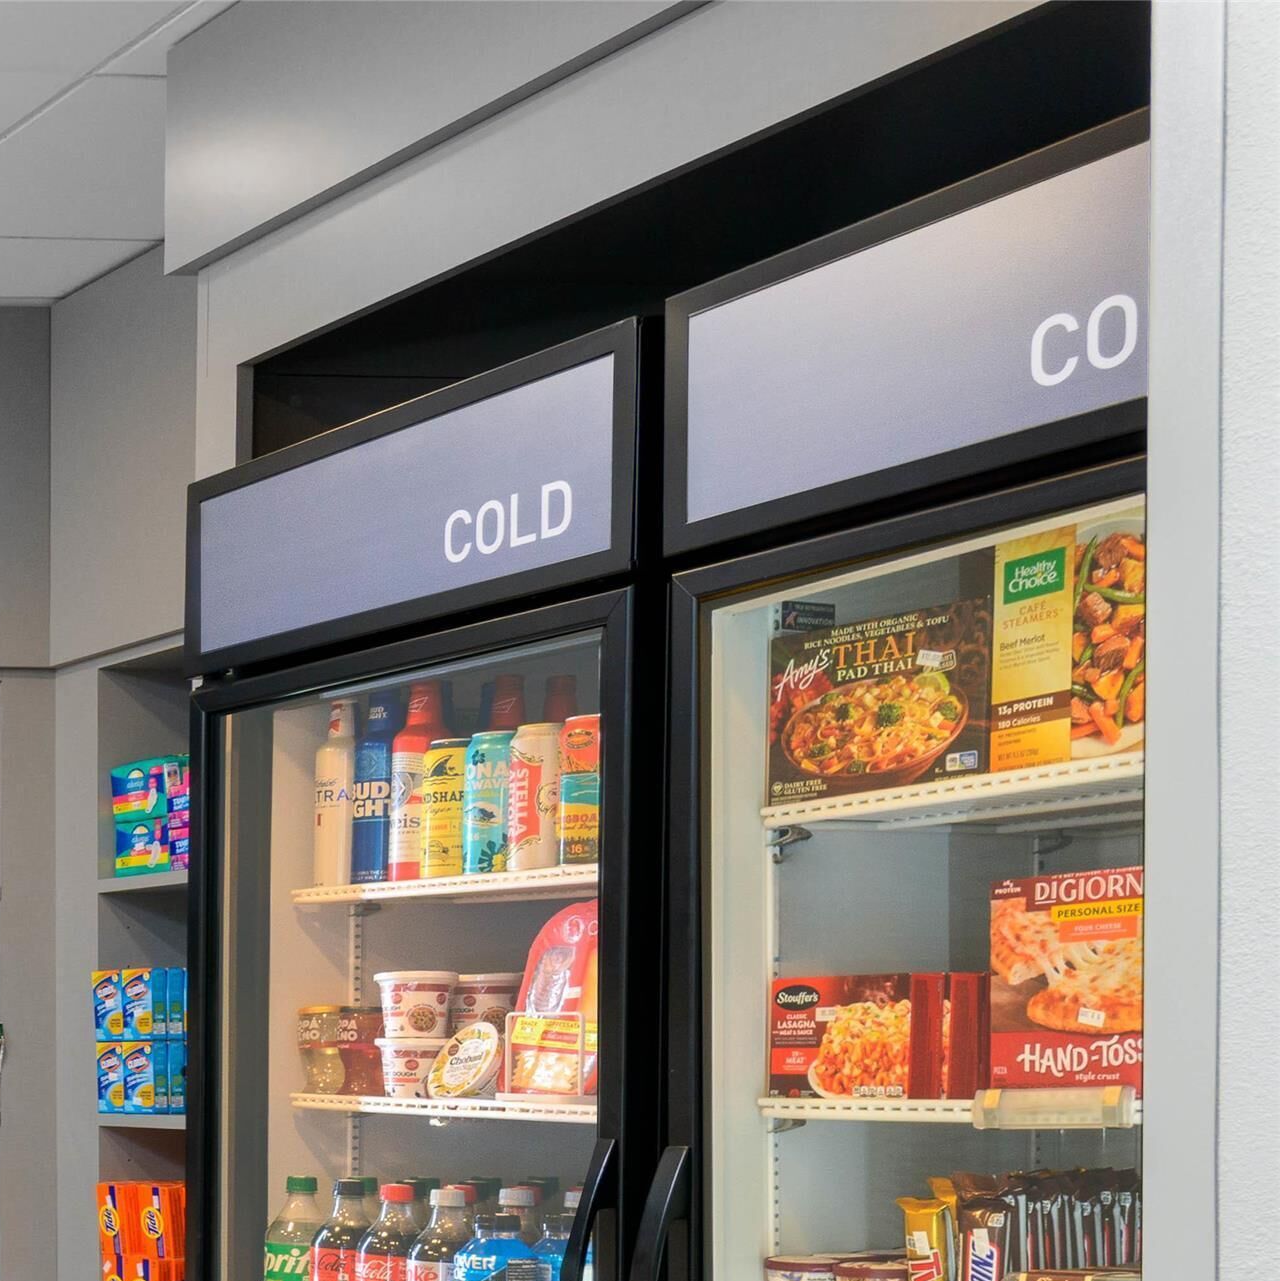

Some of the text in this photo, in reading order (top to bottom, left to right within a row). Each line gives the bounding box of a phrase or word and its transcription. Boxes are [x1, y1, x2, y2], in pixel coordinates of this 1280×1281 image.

[443, 480, 573, 565] COLD
[1015, 560, 1057, 579] Healthy
[1008, 571, 1059, 593] Choice
[831, 614, 918, 637] MADE WITH ORGANIC
[832, 632, 916, 669] THAI
[774, 648, 833, 702] Amy's
[837, 658, 913, 682] PAD THAI
[1013, 696, 1054, 713] PROTEIN
[514, 767, 529, 840] STELLA
[1057, 903, 1140, 918] PERSONAL SIZE
[777, 991, 819, 1005] Stouffer's
[777, 1021, 816, 1029] LASAGNA
[105, 1208, 116, 1233] Tide
[146, 1210, 159, 1236] Tide
